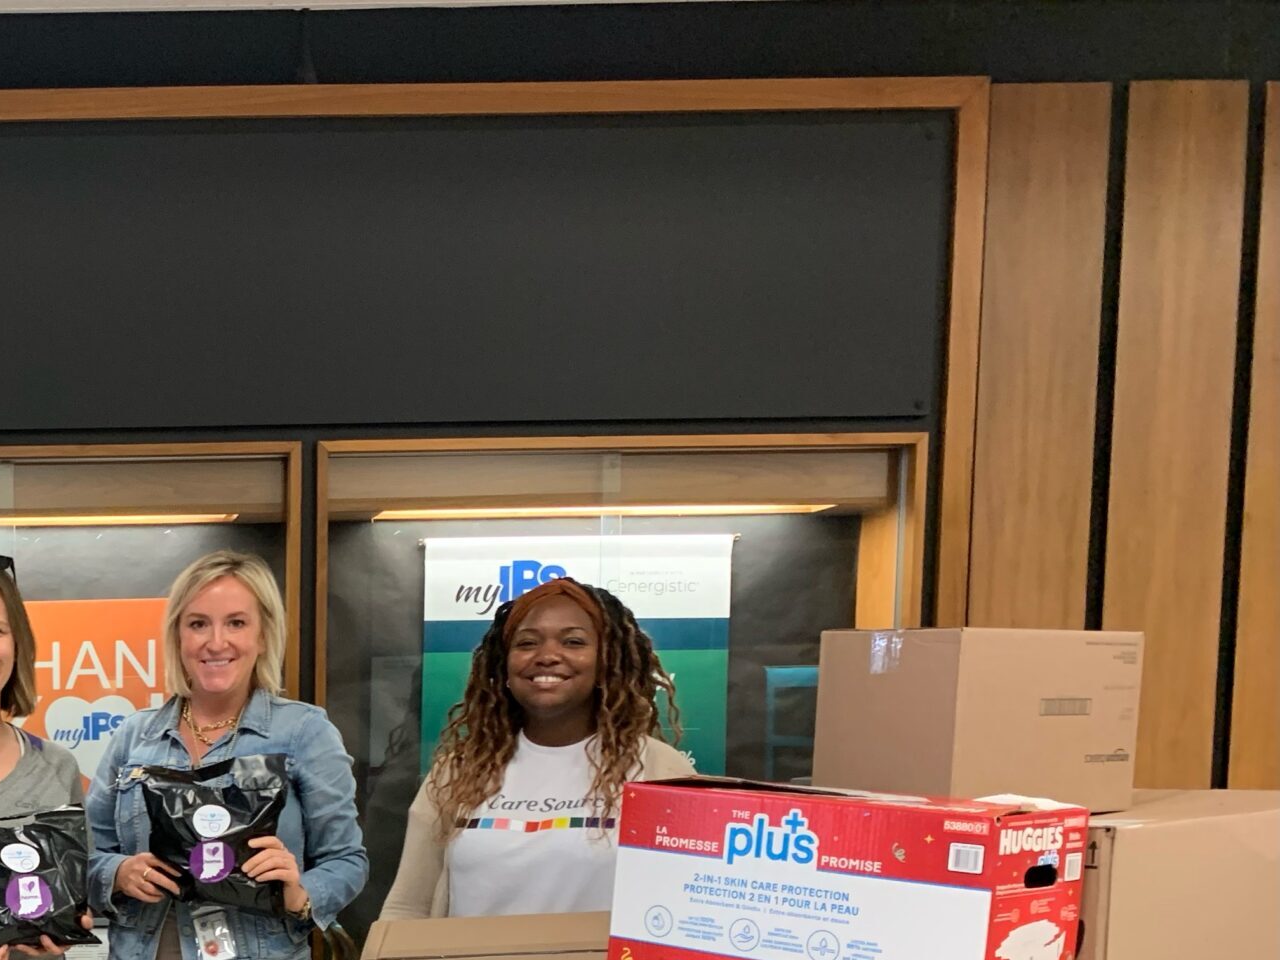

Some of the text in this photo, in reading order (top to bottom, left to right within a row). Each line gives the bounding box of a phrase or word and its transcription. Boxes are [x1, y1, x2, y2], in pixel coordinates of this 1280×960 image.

[606, 579, 697, 596] Cenergistic
[34, 639, 156, 690] HAN
[489, 794, 605, 813] CareSourc
[732, 809, 751, 820] THE
[656, 825, 668, 835] LA
[655, 835, 719, 852] PROMESSE
[999, 826, 1063, 855] HUGGIES
[821, 855, 882, 873] PROMISE
[693, 873, 850, 902] 2-IN-1 SKIN CARE PROTECTION
[683, 883, 860, 916] PROTECTION 2 EN 1 POUR LA PEAU
